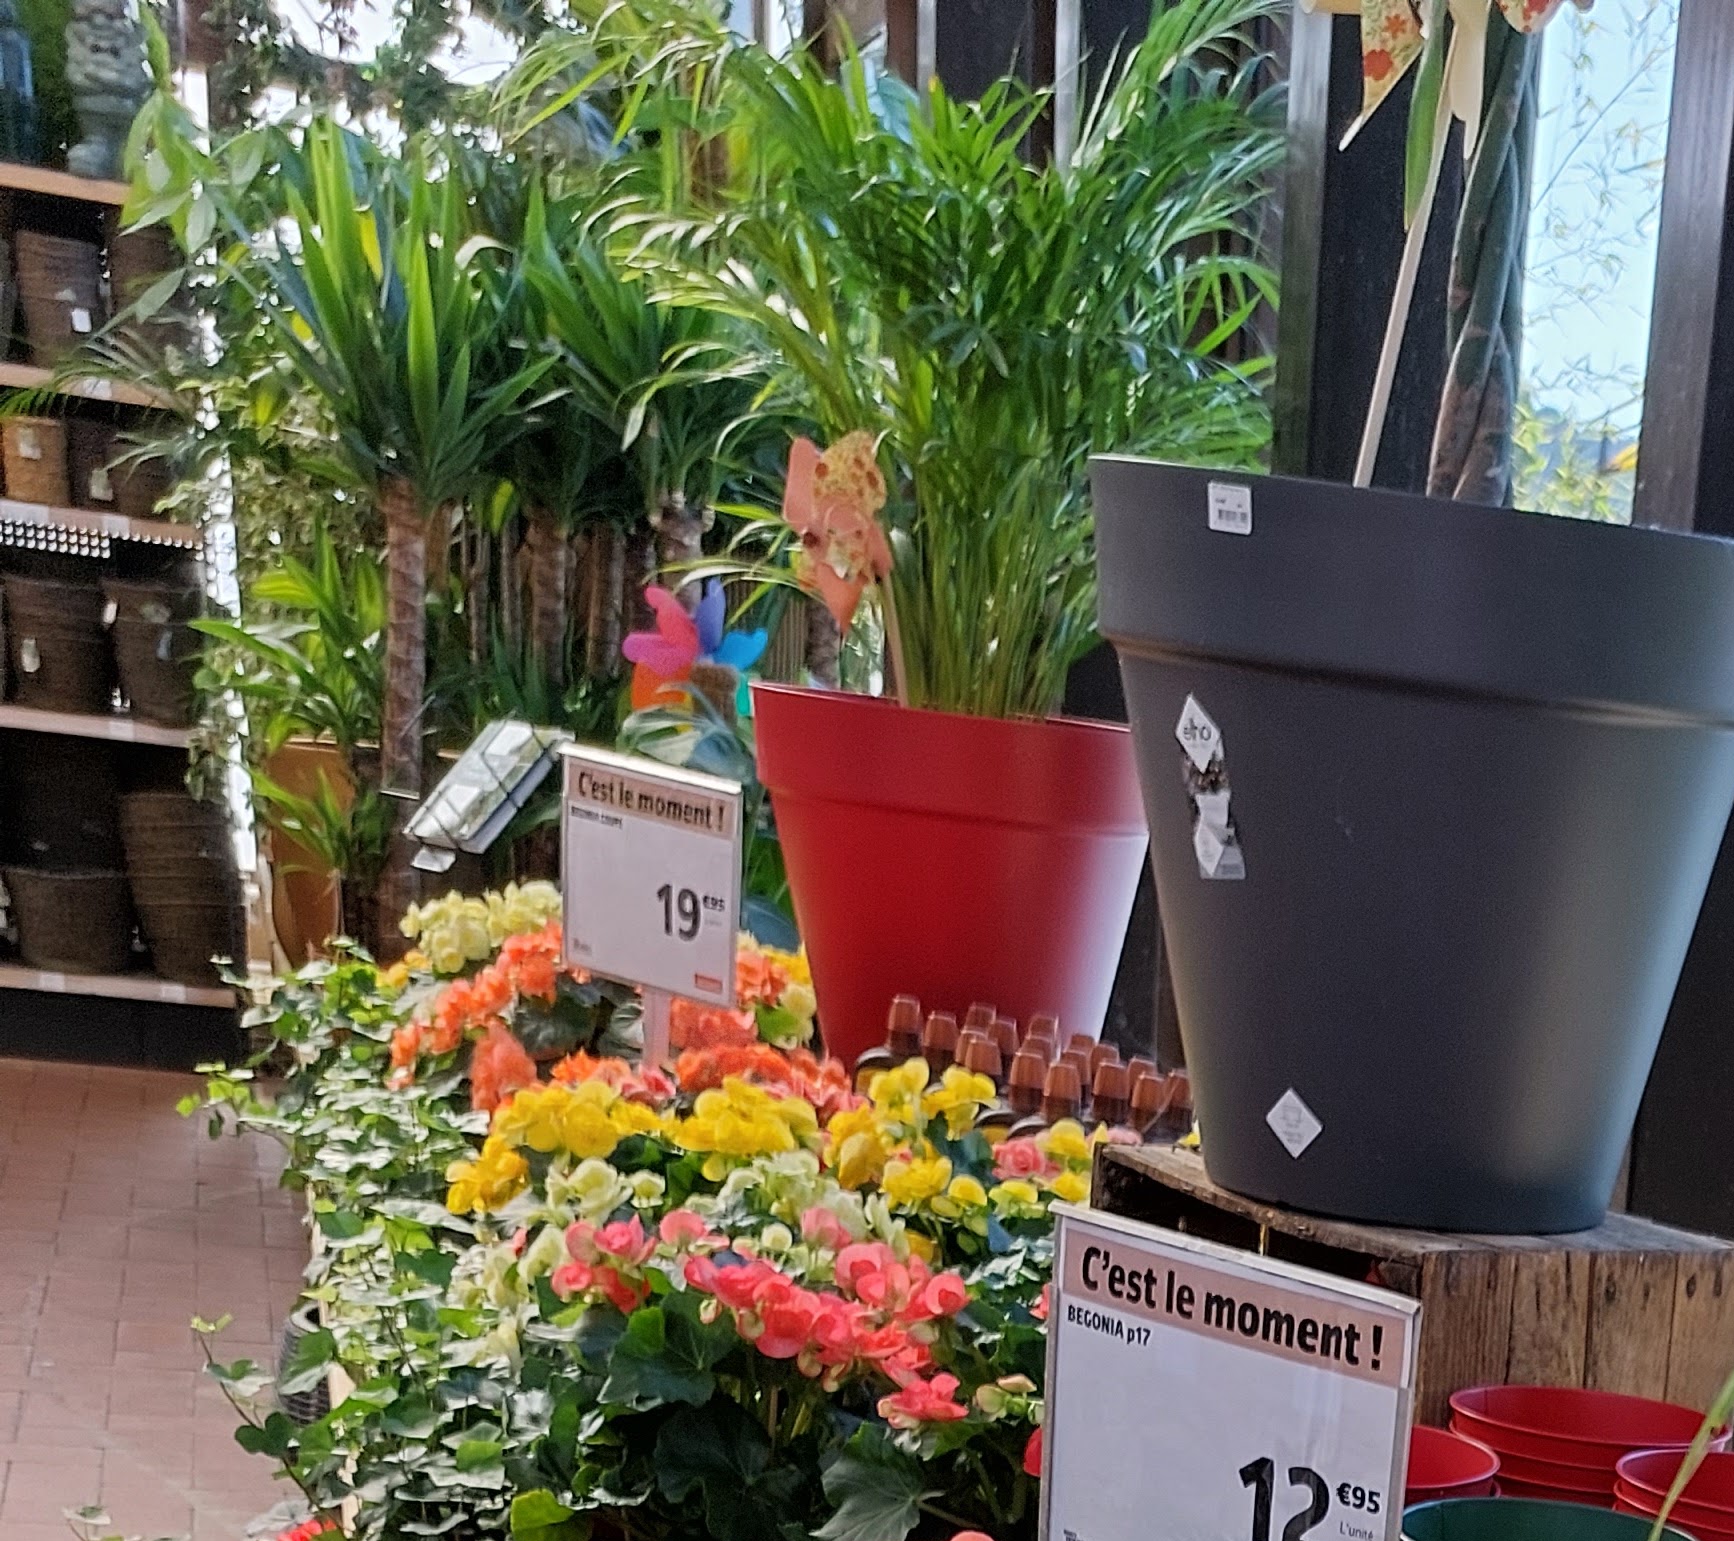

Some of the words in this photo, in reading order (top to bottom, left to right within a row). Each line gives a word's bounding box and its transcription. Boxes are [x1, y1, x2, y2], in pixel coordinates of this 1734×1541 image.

[578, 771, 615, 805] C'est
[619, 781, 634, 809] le
[638, 792, 712, 829] moment
[717, 805, 725, 832] !
[657, 883, 701, 941] 19
[1067, 1304, 1124, 1340] BEGONIA
[1126, 1326, 1152, 1347] p17
[1082, 1245, 1158, 1310] C'est
[1165, 1270, 1196, 1320] le
[1203, 1290, 1361, 1366] moment
[1370, 1324, 1384, 1371] !
[1336, 1482, 1381, 1515] €95
